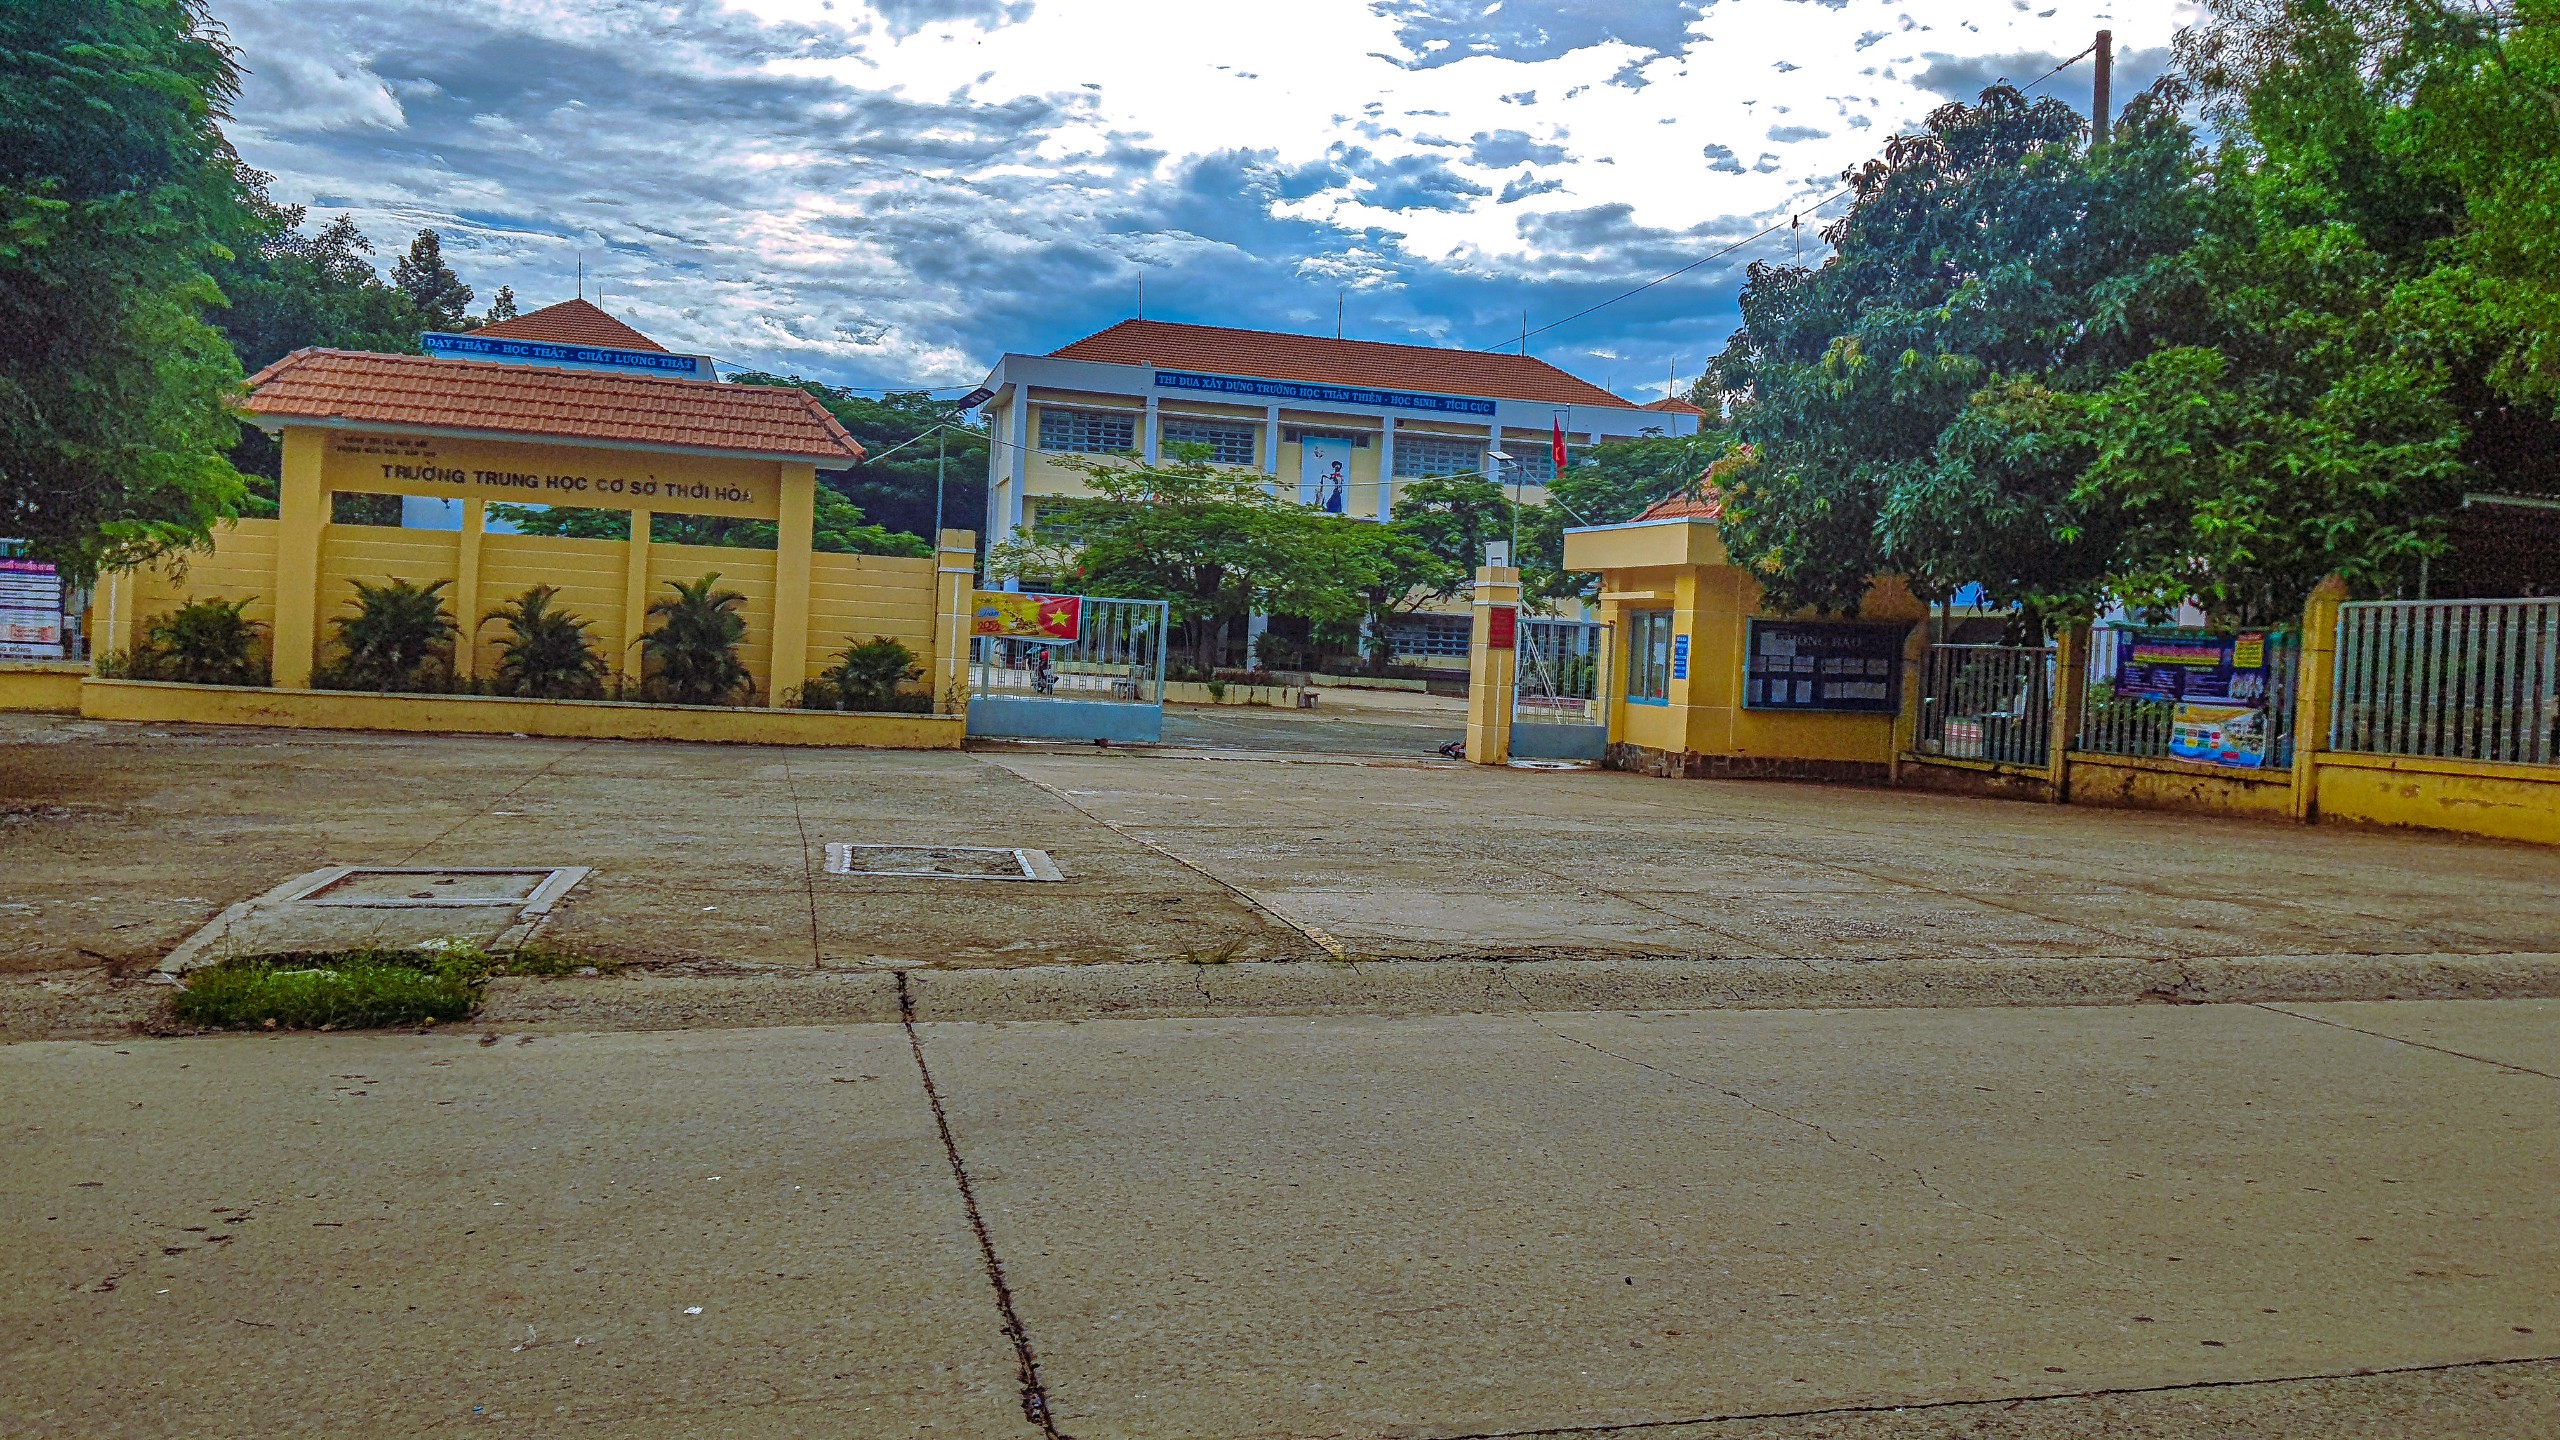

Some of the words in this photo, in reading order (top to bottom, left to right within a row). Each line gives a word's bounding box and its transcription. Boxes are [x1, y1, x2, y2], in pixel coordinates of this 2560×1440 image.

[427, 337, 454, 350] DẠY
[456, 340, 491, 353] THẬT
[502, 344, 529, 355] HỌC
[532, 347, 567, 358] THẬT
[577, 350, 612, 362] CHẤT
[615, 354, 656, 365] LƯỢNG
[660, 357, 693, 369] THẬT
[1158, 374, 1176, 385] THI
[1179, 377, 1200, 387] ĐUA
[1202, 378, 1223, 389] XÂY
[1225, 381, 1254, 392] DỰNG
[1256, 383, 1297, 396] TRƯỜNG
[1299, 388, 1320, 399] HỌC
[1322, 390, 1350, 400] THÂN
[1352, 392, 1382, 403] THIỆN
[1390, 395, 1411, 406] HỌC
[1413, 397, 1437, 408] SINH
[1446, 398, 1468, 410] TÍCH
[1470, 402, 1490, 412] CỰC
[381, 460, 466, 484] TRƯỜNG
[472, 470, 539, 489] TRUNG
[546, 475, 588, 493] HỌC
[596, 477, 624, 493] CƠ
[629, 474, 657, 496] SỞ
[715, 482, 754, 503] HÒA
